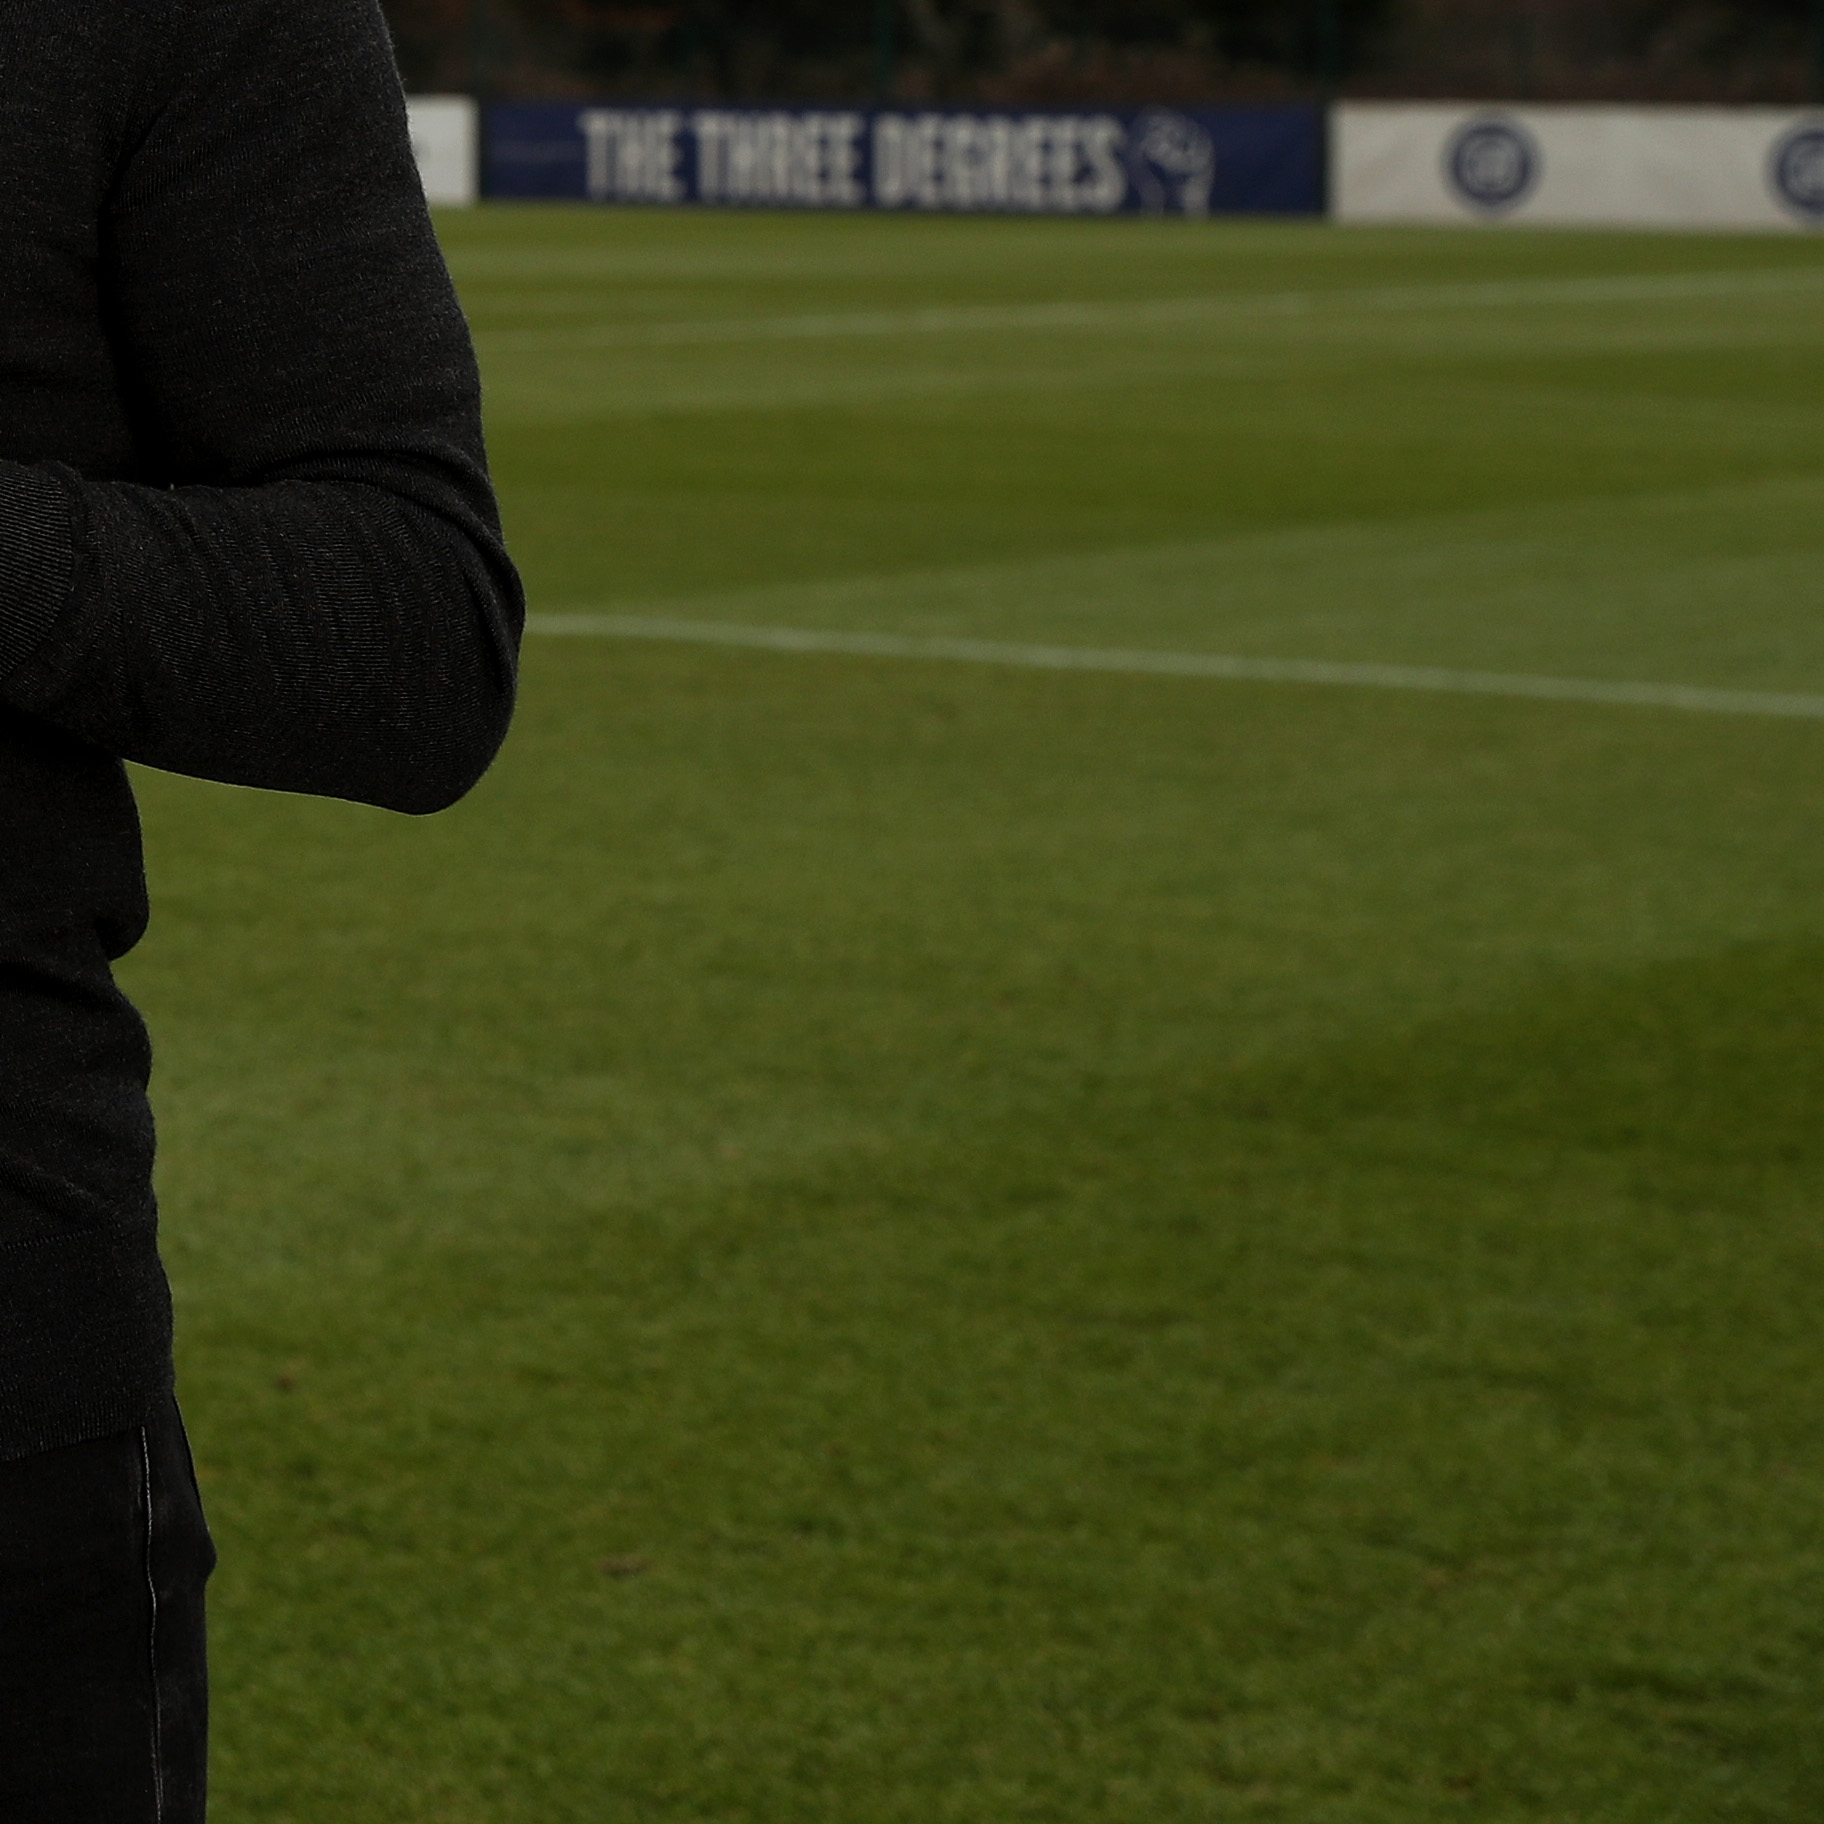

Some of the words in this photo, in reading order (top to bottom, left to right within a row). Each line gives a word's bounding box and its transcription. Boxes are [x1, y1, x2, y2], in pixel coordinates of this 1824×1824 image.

[577, 108, 683, 203] THE
[690, 109, 864, 206] THREE
[872, 112, 1128, 214] DEGREES
